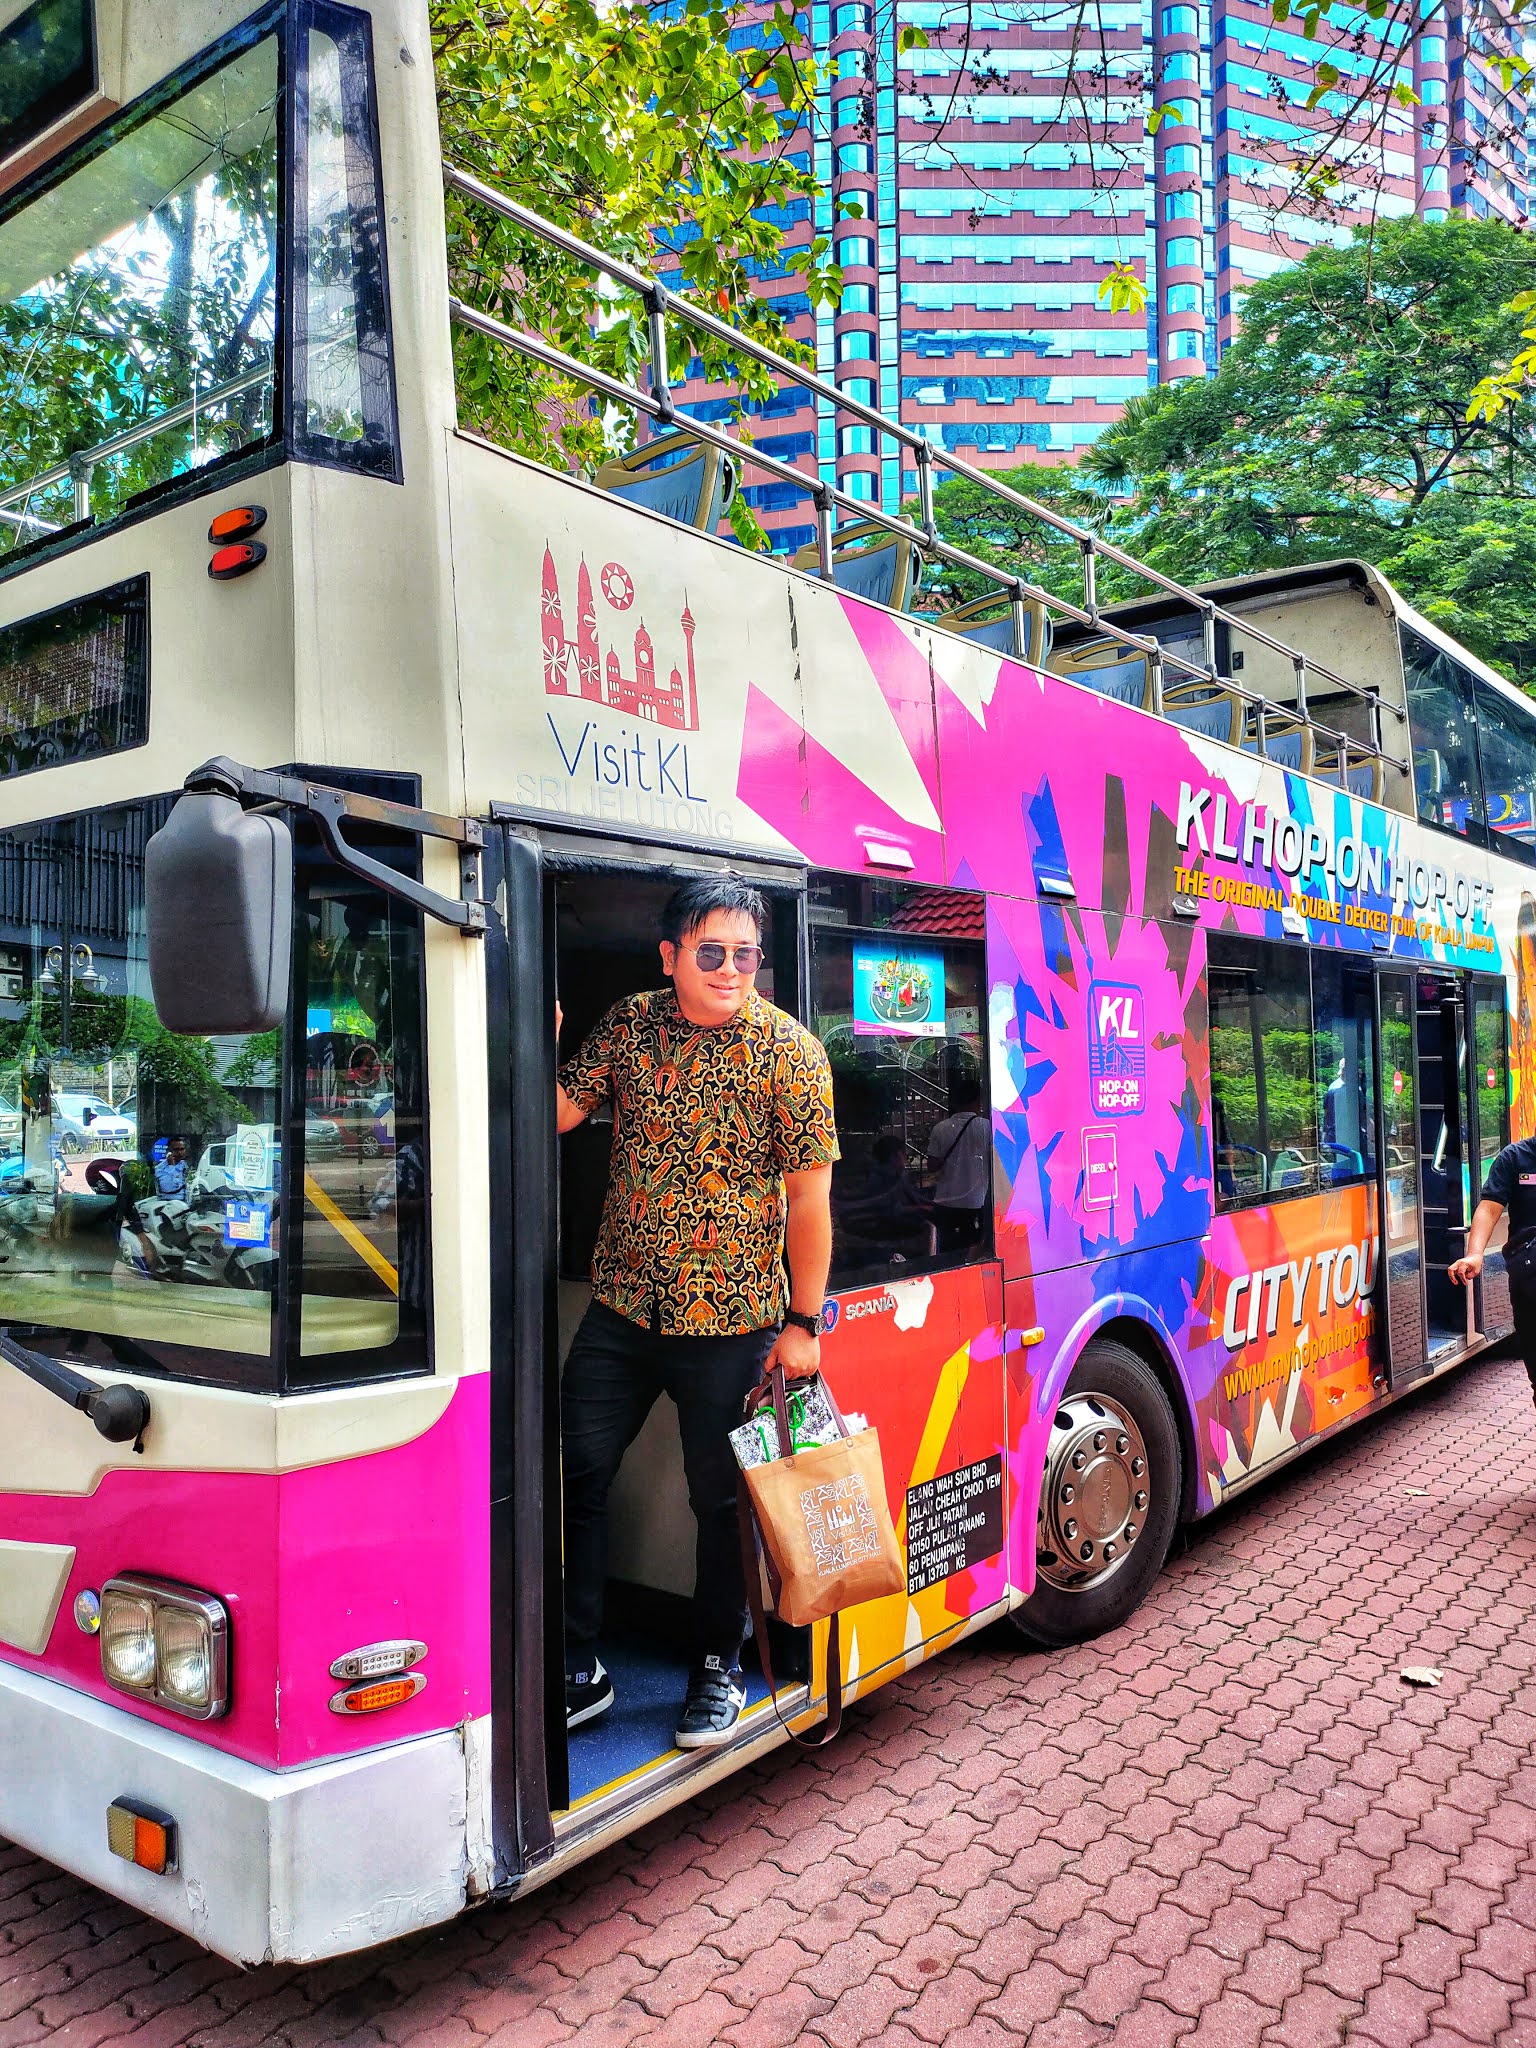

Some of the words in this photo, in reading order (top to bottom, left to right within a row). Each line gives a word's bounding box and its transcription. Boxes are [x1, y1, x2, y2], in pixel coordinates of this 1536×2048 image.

[1175, 780, 1238, 864] KL
[1242, 803, 1383, 898] HOP-ON
[1389, 853, 1495, 925] HOP-OFF
[1173, 865, 1211, 900] THE
[1212, 874, 1284, 914] ORIGINAL
[1290, 892, 1342, 925] DOUBLE
[1345, 903, 1389, 933] DECKER
[1391, 914, 1418, 939] TOUR
[1419, 921, 1433, 942] OF
[1434, 925, 1463, 948] KUALA
[1465, 931, 1495, 954] LUMPUR
[1098, 995, 1140, 1040] KL
[1098, 1093, 1140, 1108] HOP-OFF
[1099, 1079, 1139, 1095] HOP-ON
[1090, 1163, 1107, 1174] DIESEL
[845, 1294, 896, 1320] SCANIA
[1223, 1255, 1313, 1353] CITY
[1317, 1236, 1380, 1317] TOU
[908, 1483, 934, 1505] ELANG
[936, 1475, 953, 1494] WAH
[955, 1469, 970, 1487] SDN
[972, 1462, 987, 1480] BHD
[908, 1500, 933, 1523] JALAN
[935, 1489, 961, 1511] CHEAH
[963, 1479, 984, 1501] CHOO
[985, 1472, 1001, 1491] YEW
[908, 1521, 924, 1540] OFF
[926, 1514, 941, 1533] JLN
[908, 1536, 931, 1558] 10150
[932, 1524, 957, 1545] PULAU
[958, 1511, 986, 1536] PINANG
[908, 1557, 920, 1576] 60
[921, 1538, 966, 1570] PENUMPANG
[908, 1574, 926, 1594] BTM
[955, 1554, 966, 1571] KG
